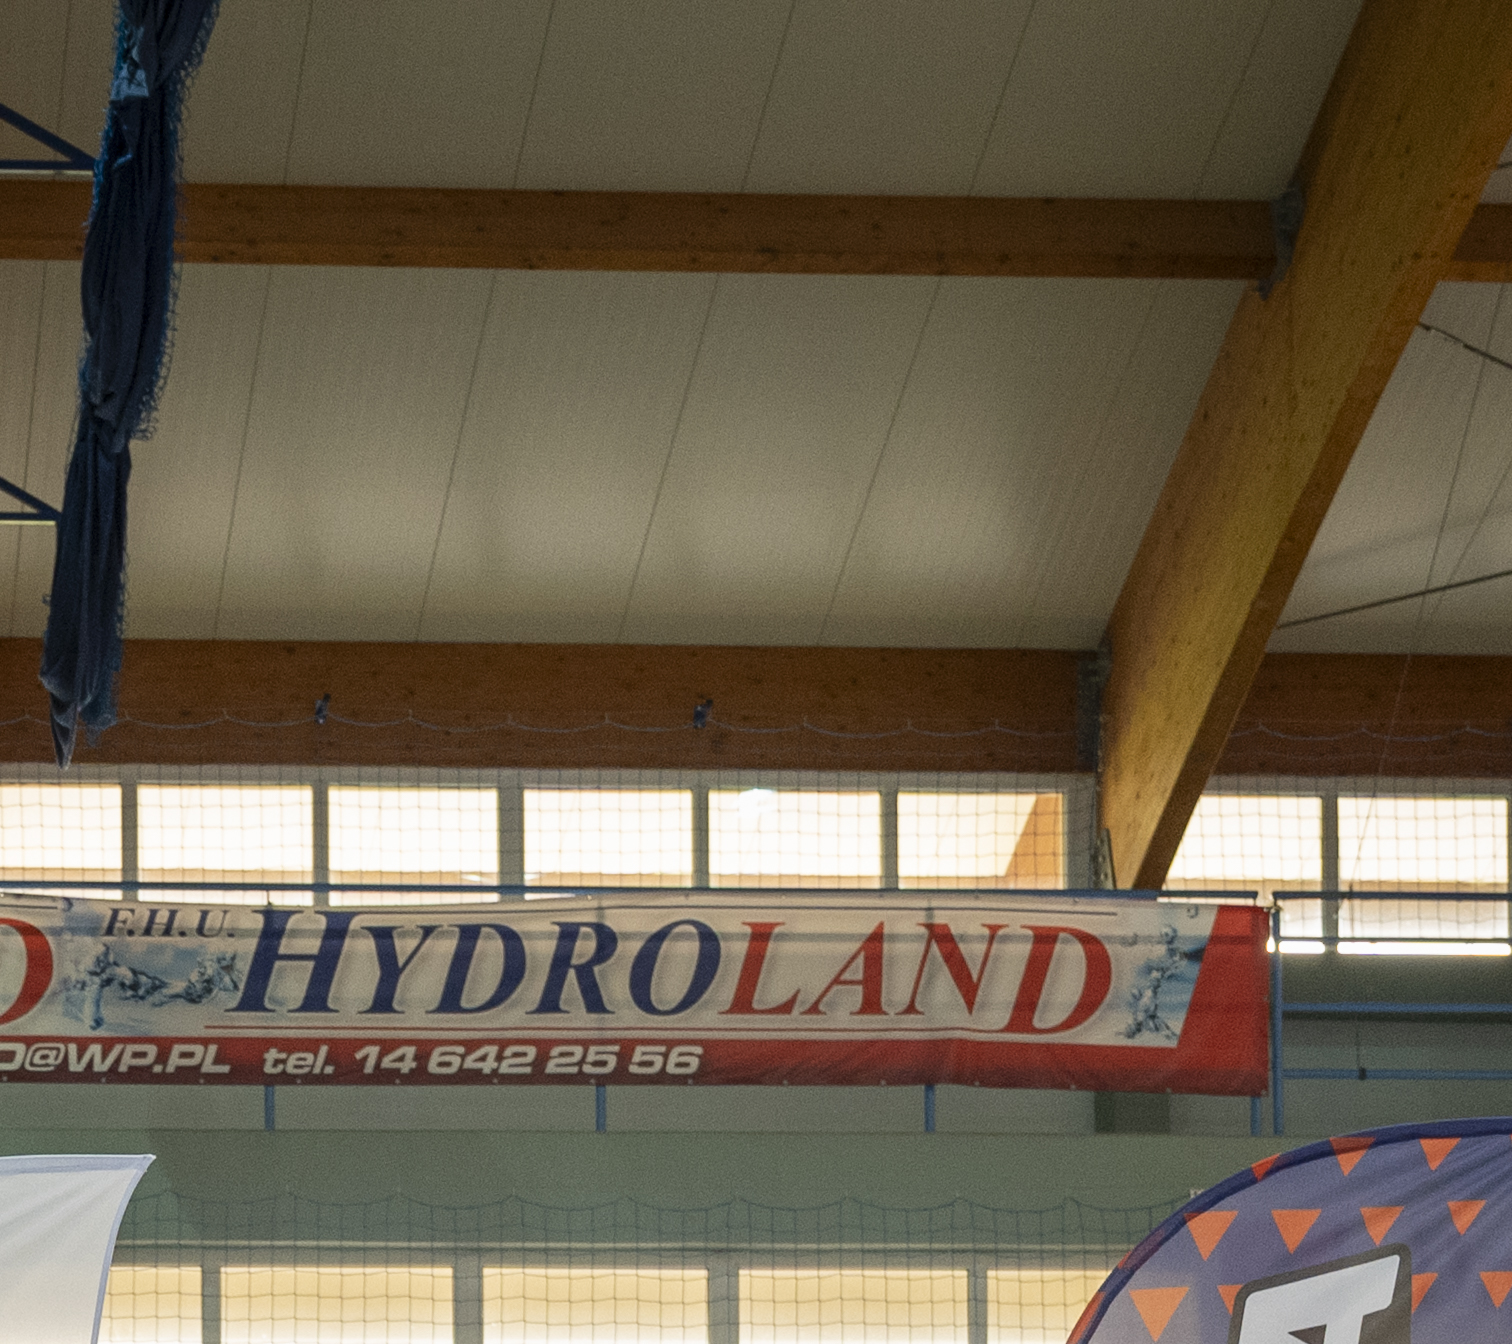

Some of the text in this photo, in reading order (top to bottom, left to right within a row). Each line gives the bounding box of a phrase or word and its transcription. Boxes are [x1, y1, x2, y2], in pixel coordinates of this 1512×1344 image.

[103, 908, 1114, 1036] F.H.U. HYDROLAND
[263, 1045, 334, 1076] tel.
[354, 1044, 418, 1075] 14
[427, 1044, 534, 1075] 642
[544, 1044, 619, 1075] 25
[627, 1044, 706, 1075] 56
